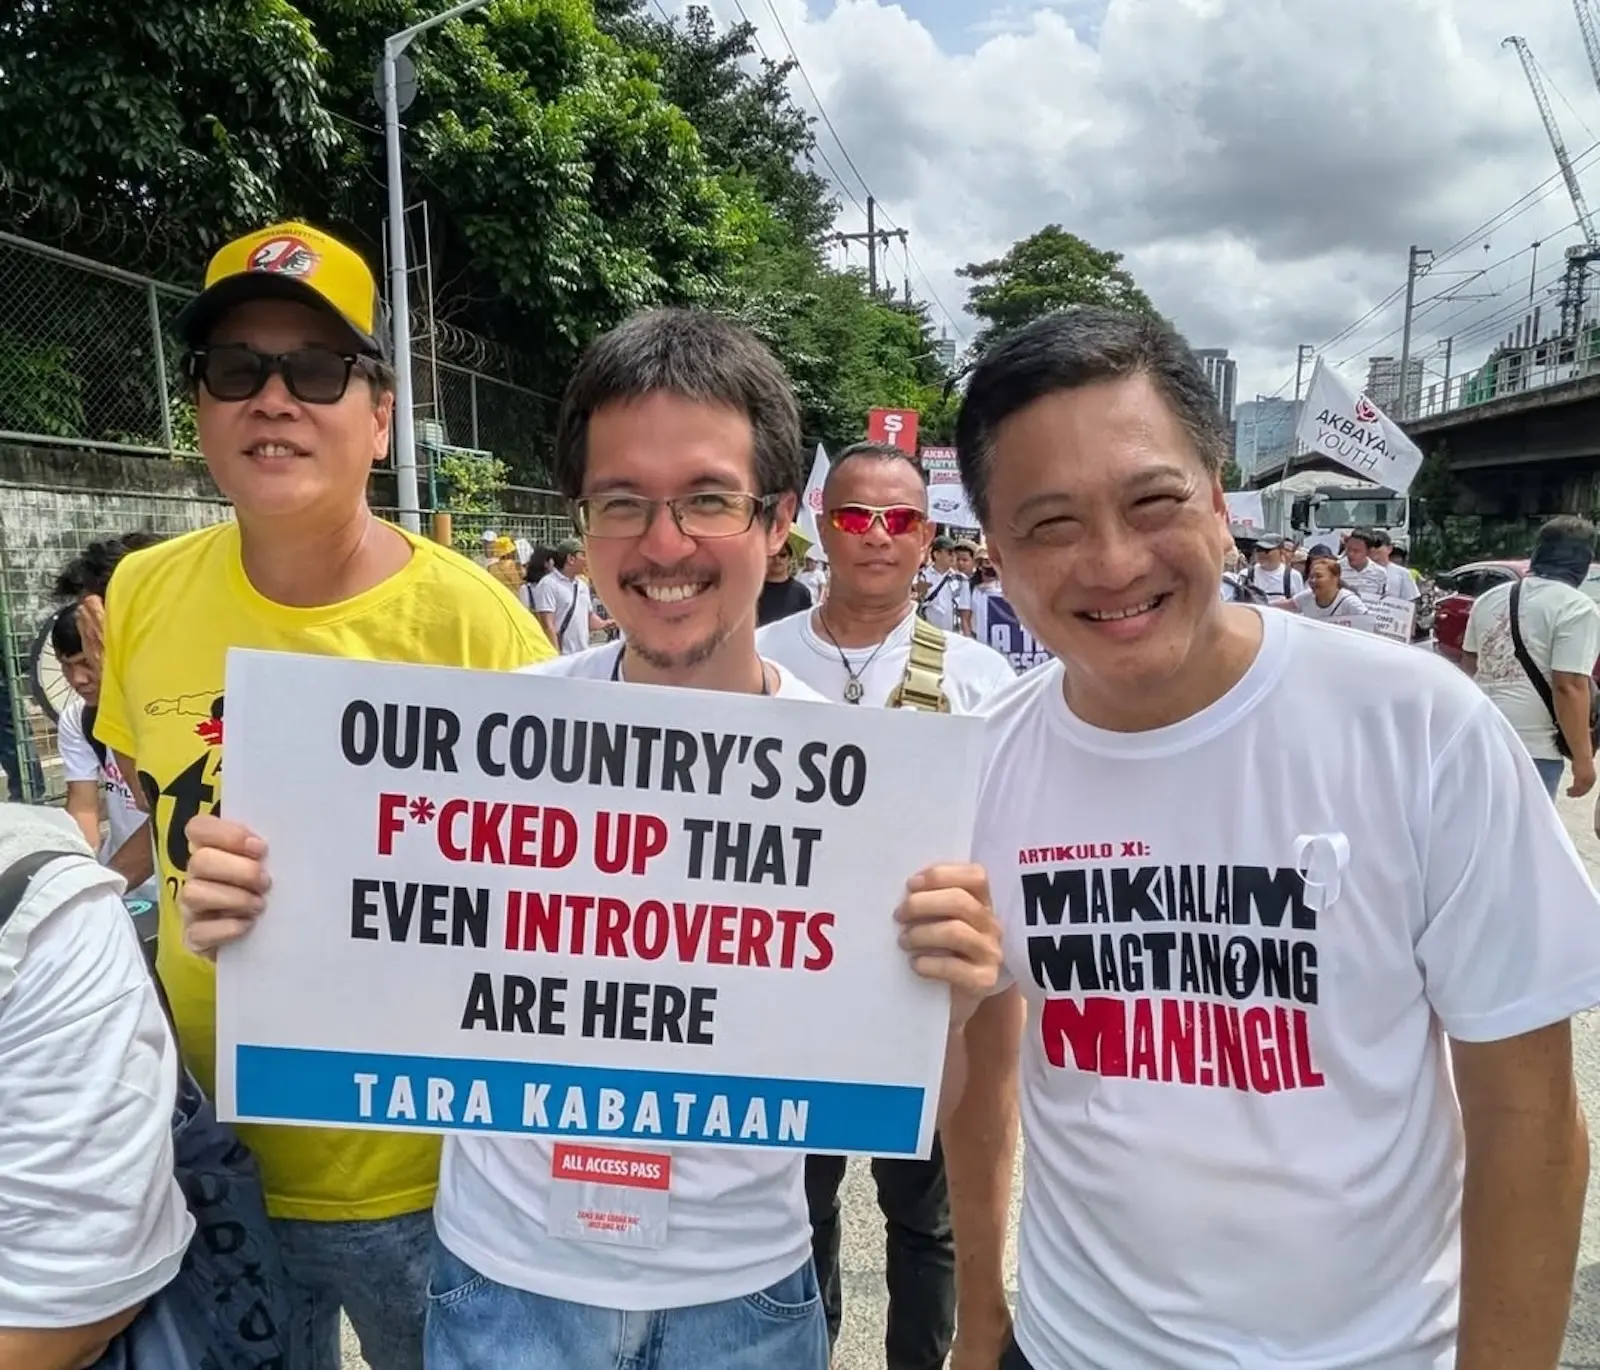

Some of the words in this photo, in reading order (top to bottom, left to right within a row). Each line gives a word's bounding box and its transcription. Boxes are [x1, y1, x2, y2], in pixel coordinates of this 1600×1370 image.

[1316, 409, 1396, 462] AKBAYA
[1316, 427, 1378, 471] YOUTH
[340, 700, 460, 773] OUR
[477, 713, 783, 800] COUNTRY'S
[795, 741, 867, 806] SO
[593, 811, 668, 876] UP
[684, 818, 822, 888] THAT
[1018, 842, 1113, 865] ARTIKULO
[1120, 840, 1151, 858] XI:
[350, 879, 490, 949] EVEN
[504, 890, 836, 971] INTROVERTS
[1021, 864, 1317, 930] MAKIALAM
[460, 972, 568, 1036] ARE
[581, 981, 718, 1045] HERE
[353, 1073, 492, 1127] TARA
[522, 1083, 810, 1143] KABATAAN
[562, 1154, 583, 1171] ALL
[586, 1158, 628, 1176] ACCESS
[630, 1162, 661, 1179] PASS
